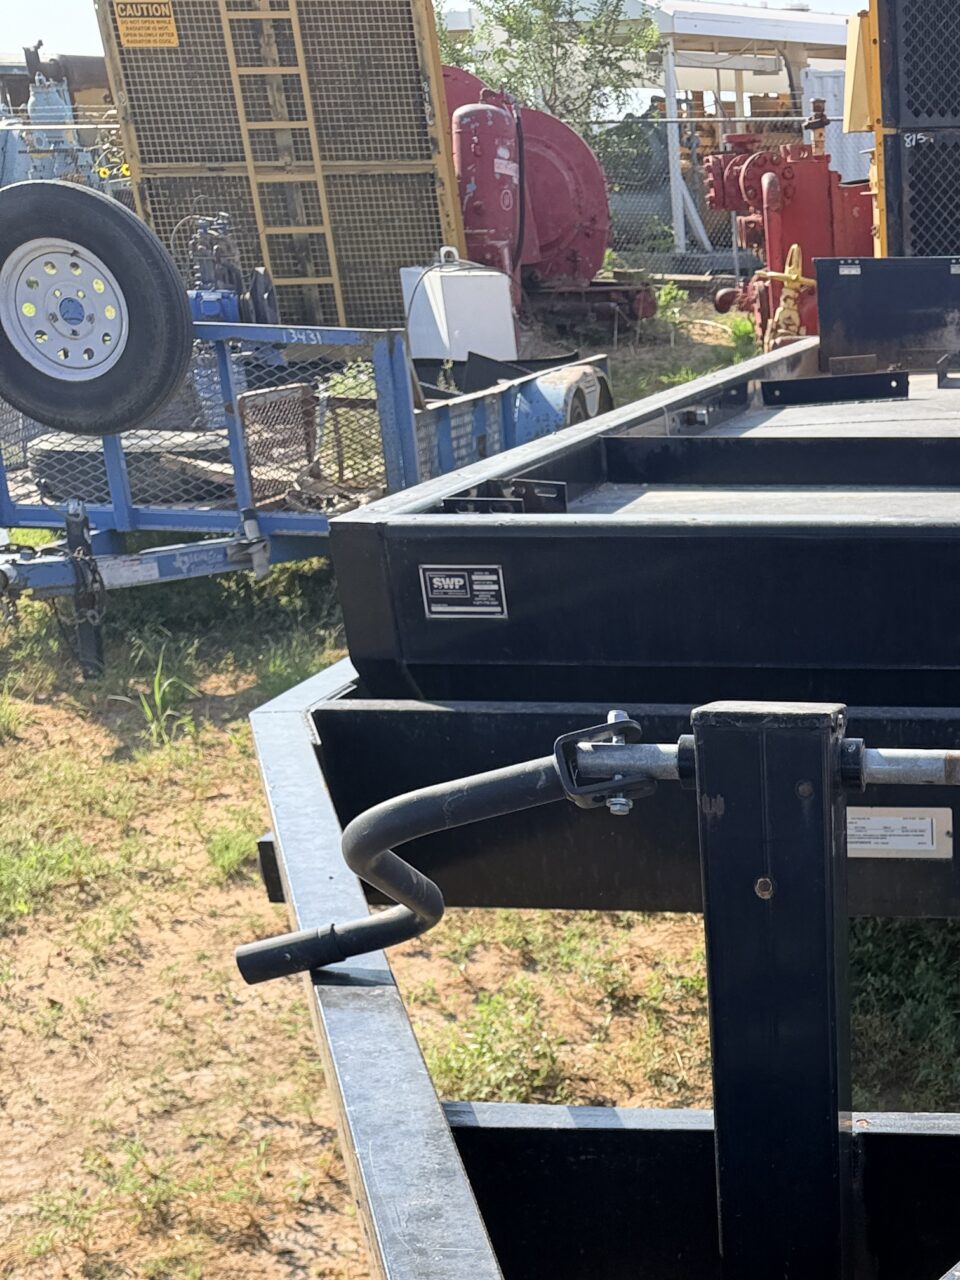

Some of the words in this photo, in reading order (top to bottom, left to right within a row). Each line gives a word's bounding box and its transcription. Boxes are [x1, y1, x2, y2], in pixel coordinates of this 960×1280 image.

[117, 3, 170, 17] CAUTION
[282, 329, 323, 345] 13431
[432, 577, 465, 590] SWP
